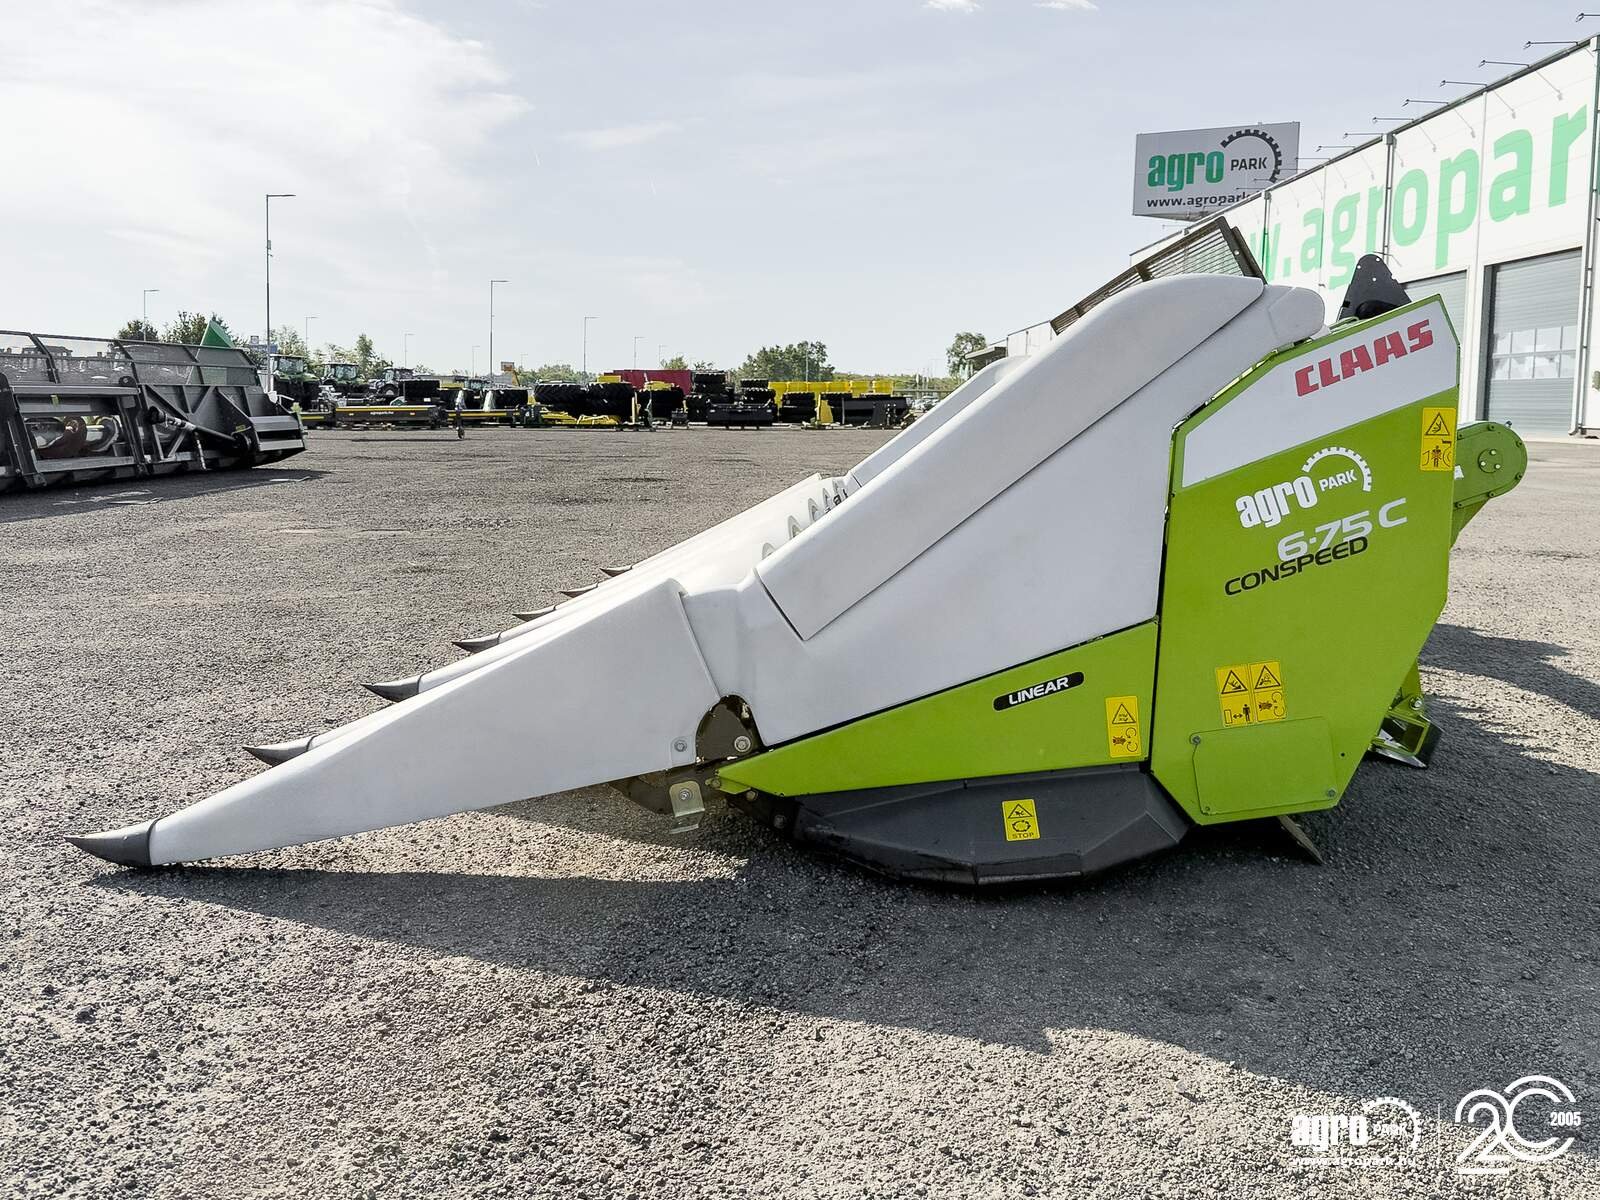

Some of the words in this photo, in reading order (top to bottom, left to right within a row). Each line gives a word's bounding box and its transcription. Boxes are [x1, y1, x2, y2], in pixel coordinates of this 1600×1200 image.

[1147, 151, 1225, 192] agro
[1230, 156, 1268, 171] PARK
[1294, 319, 1434, 397] CLAAS
[1235, 476, 1318, 529] agro
[1318, 469, 1358, 492] PARK
[1378, 497, 1408, 529] C
[1224, 536, 1369, 596] CONSPEED
[1008, 676, 1069, 705] LINEAR
